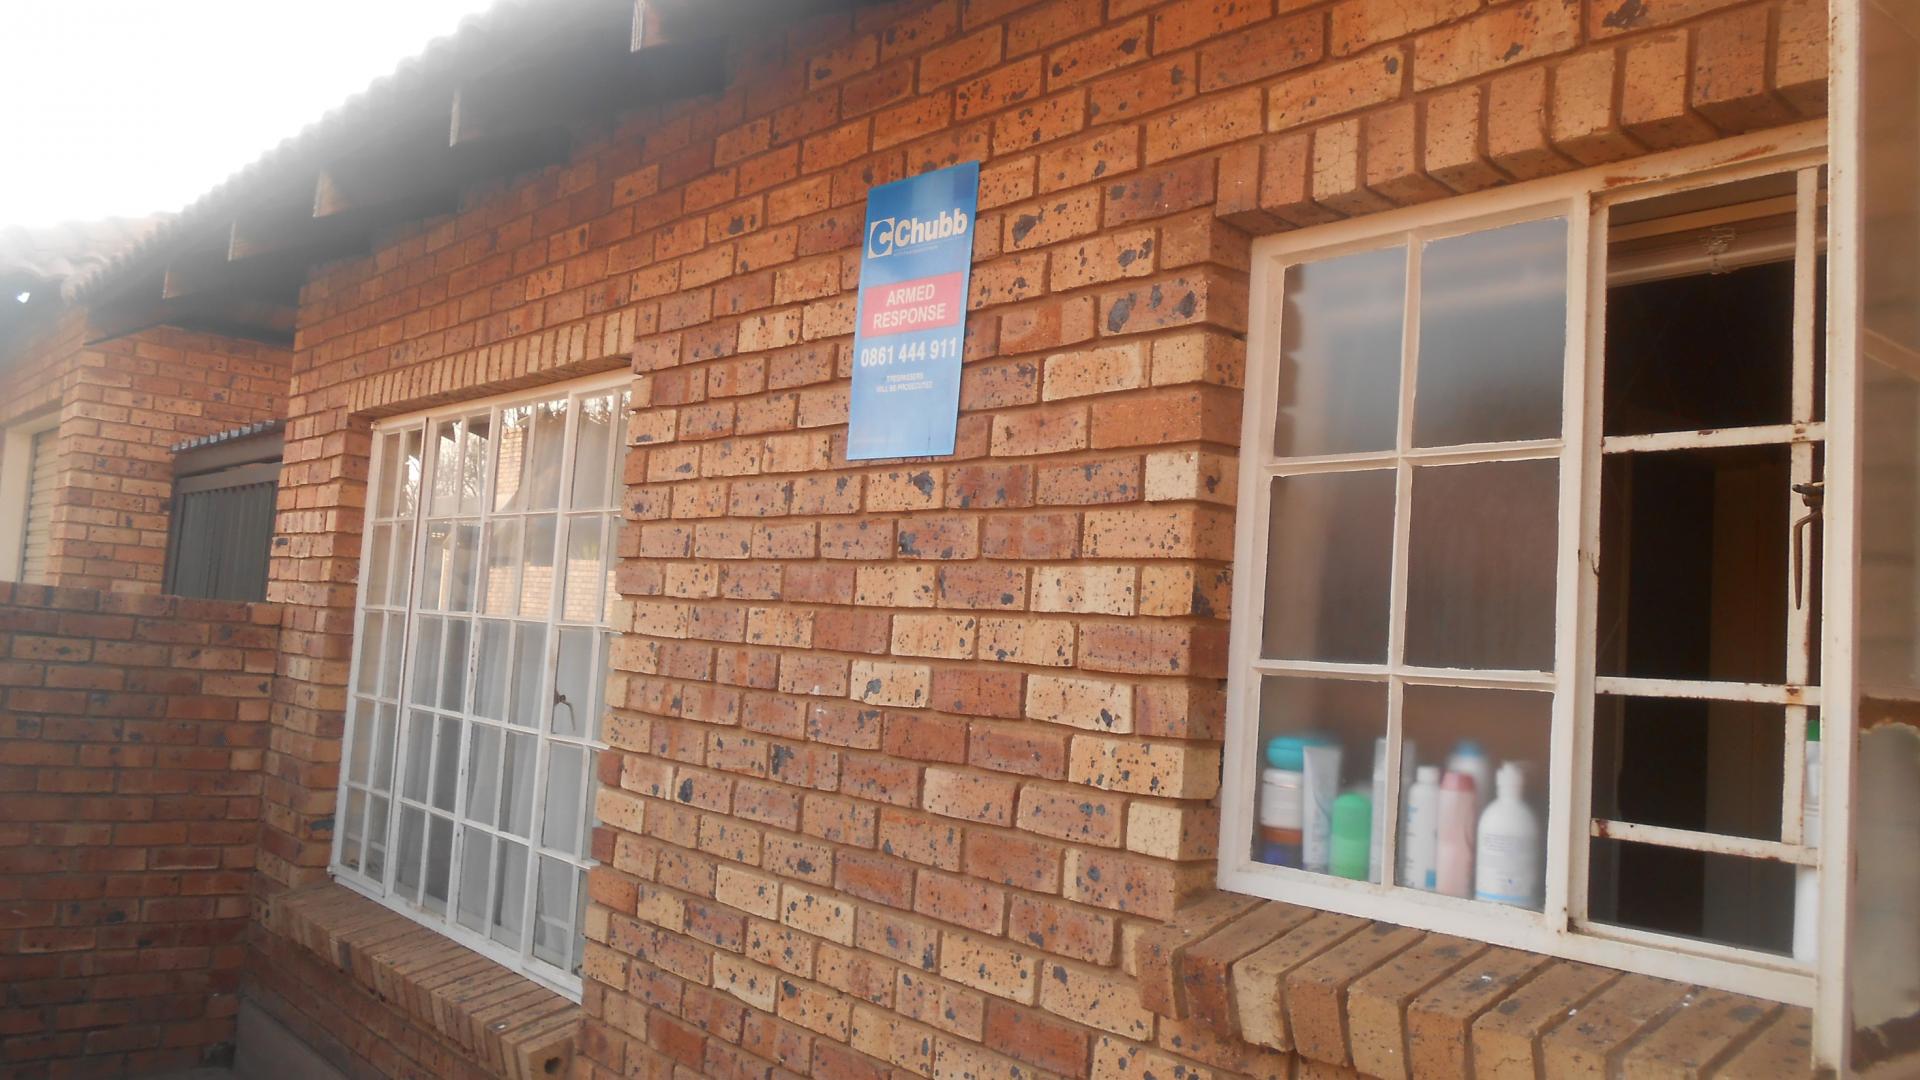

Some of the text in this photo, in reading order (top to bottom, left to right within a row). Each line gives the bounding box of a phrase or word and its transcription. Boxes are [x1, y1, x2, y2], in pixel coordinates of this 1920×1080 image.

[895, 208, 967, 247] Chubb
[887, 285, 935, 306] ARMED
[873, 303, 946, 328] RESPONSE
[861, 337, 957, 367] 0861 444 911
